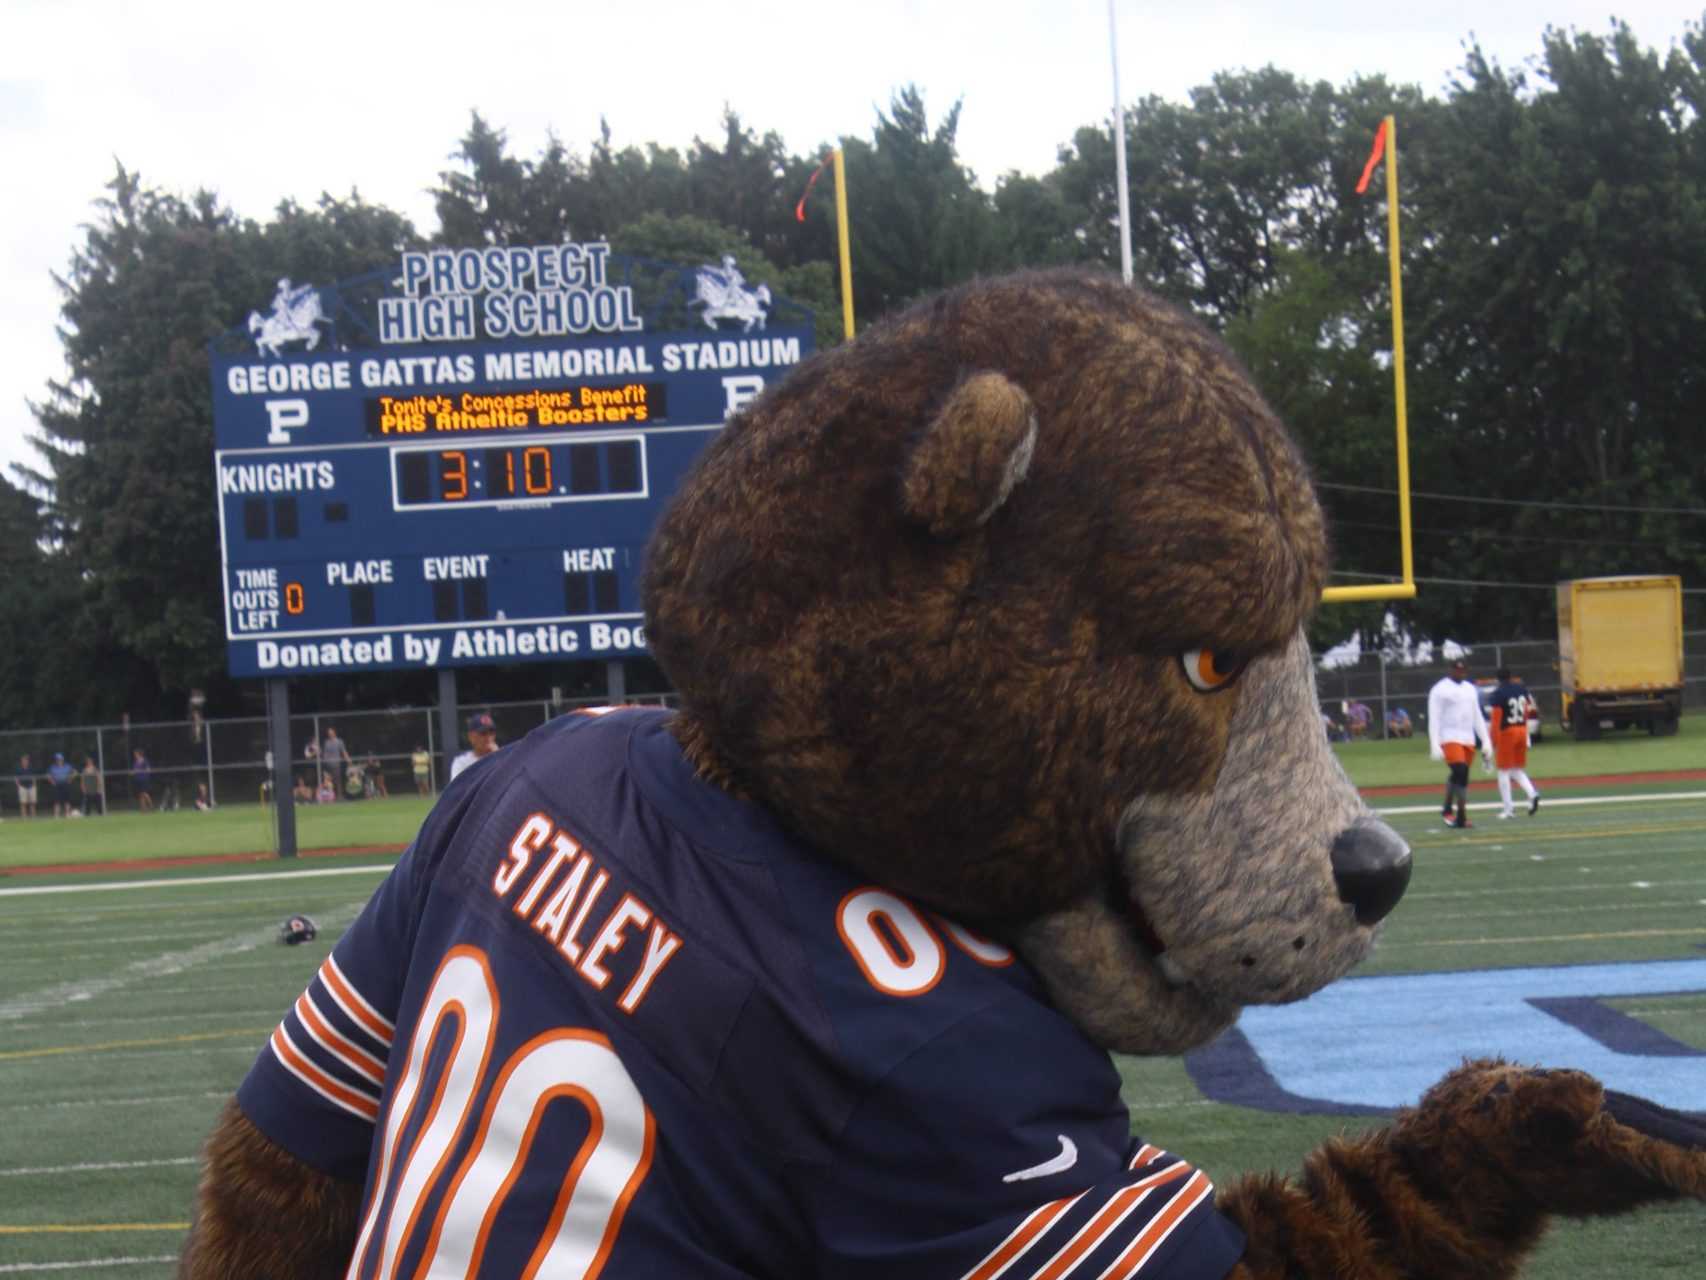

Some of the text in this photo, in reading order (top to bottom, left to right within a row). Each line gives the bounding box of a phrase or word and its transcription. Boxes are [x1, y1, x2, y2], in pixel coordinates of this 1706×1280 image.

[402, 242, 610, 297] PROSPECT
[378, 286, 643, 341] HIGH SCHOOL
[228, 338, 800, 394] GEORGE GATTAS MEMORIAL STADIUM
[380, 384, 647, 417] Tonite's Concessions Benefit
[265, 399, 309, 445] P
[381, 413, 426, 434] PHS
[538, 404, 648, 425] Boosters
[222, 461, 335, 493] KNIGHTS
[327, 560, 393, 585] PLACE
[423, 555, 489, 580] EVENT
[563, 547, 616, 572] HEAT
[236, 568, 278, 589] TIME
[233, 590, 279, 611] OUTS
[286, 583, 304, 614] 0
[238, 611, 279, 631] LEFT
[257, 635, 393, 669] Donated
[404, 633, 441, 666] by
[452, 625, 578, 658] Athletic
[493, 812, 682, 1015] STALEY
